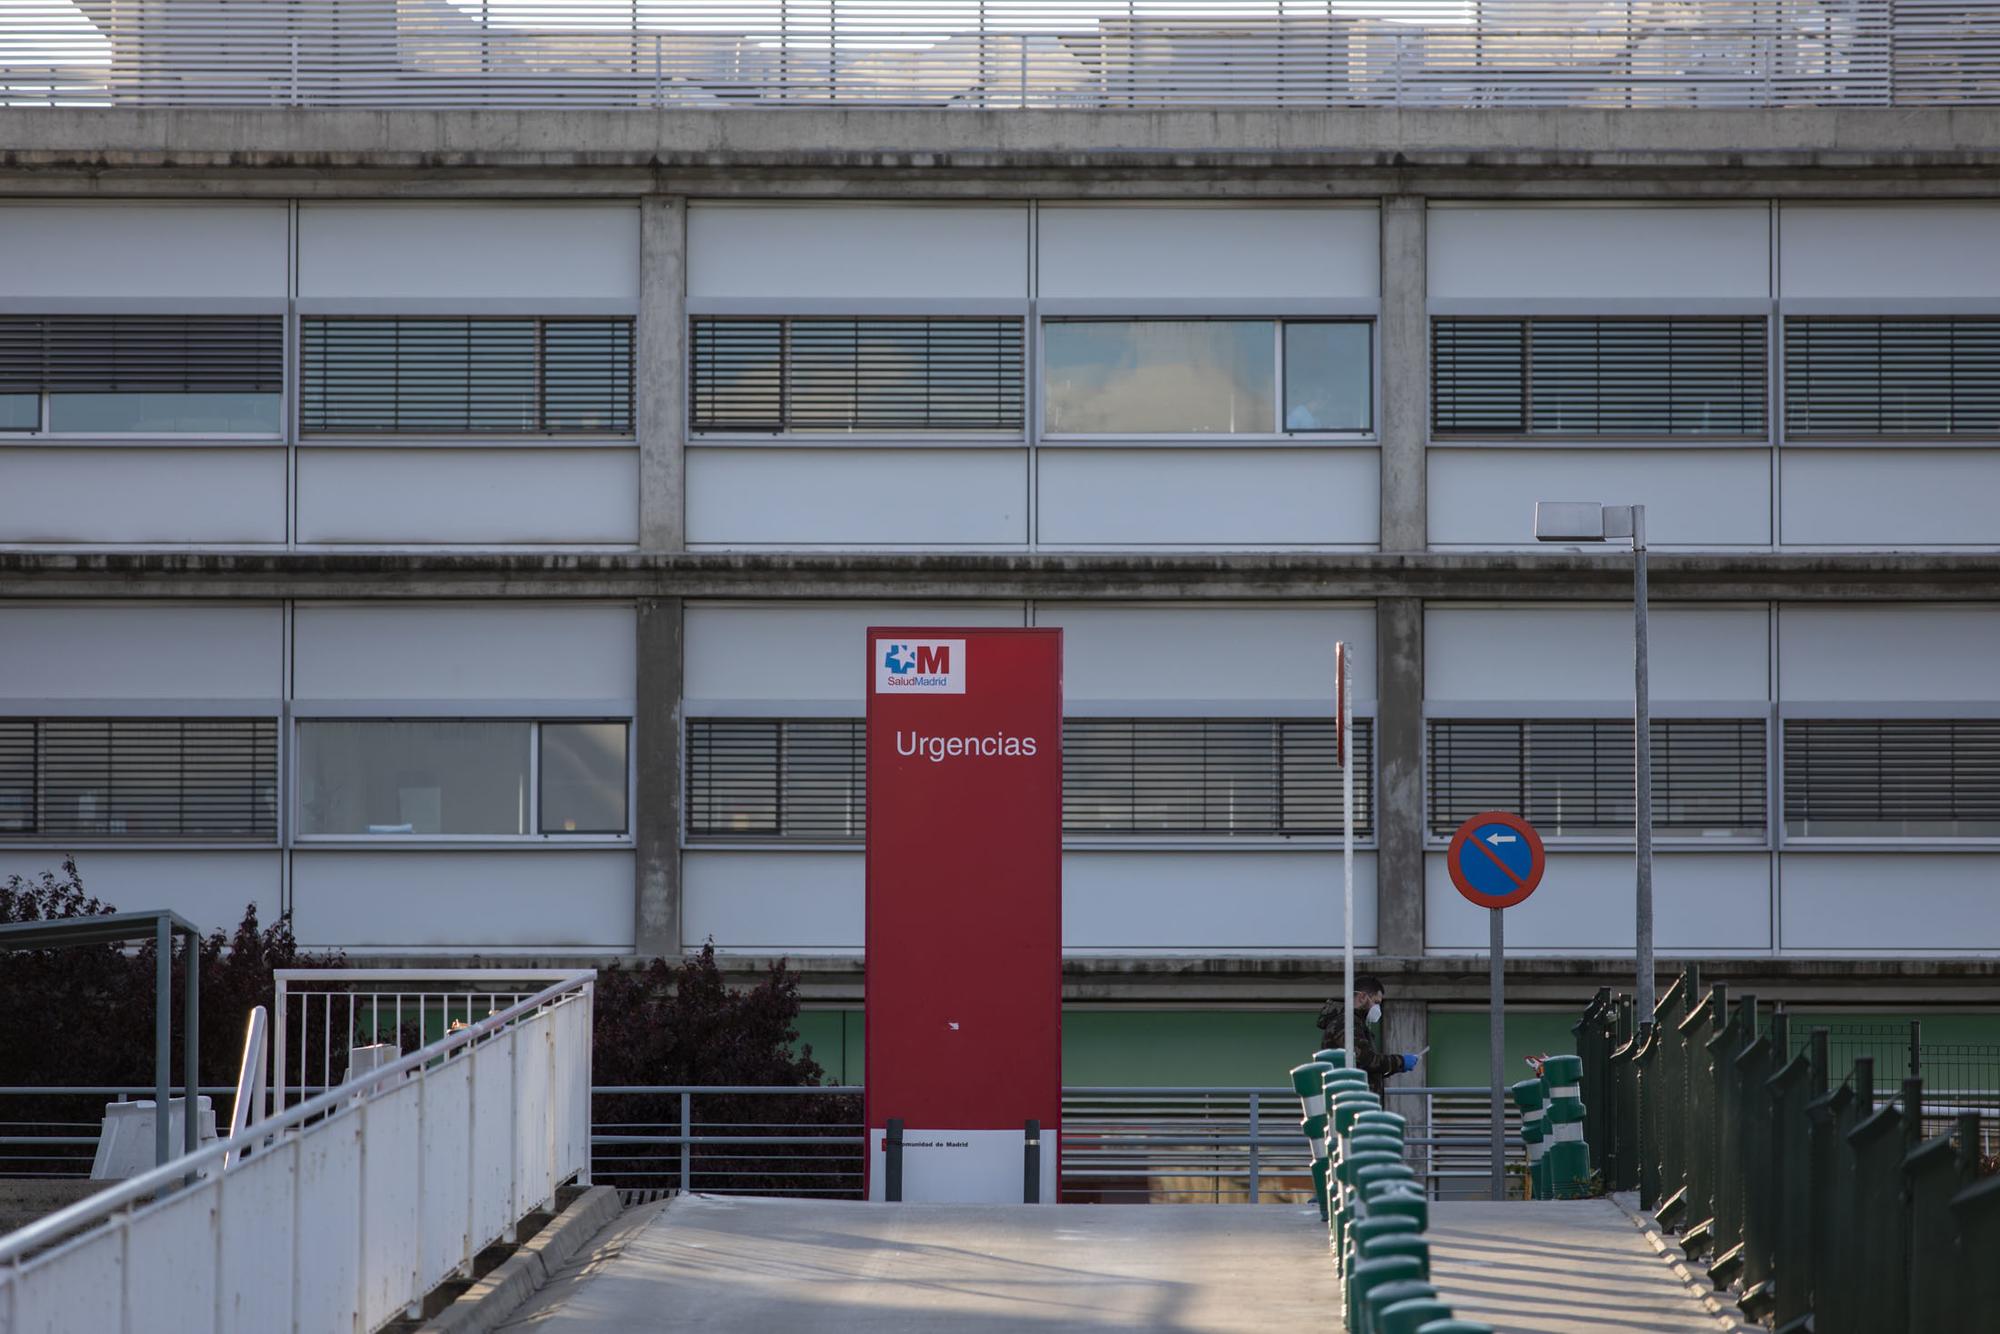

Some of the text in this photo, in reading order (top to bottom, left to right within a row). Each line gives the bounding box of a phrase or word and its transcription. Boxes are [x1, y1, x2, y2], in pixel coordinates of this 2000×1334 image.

[917, 646, 949, 674] M
[888, 677, 946, 686] SaludMadrid
[897, 731, 1037, 762] Urgencias
